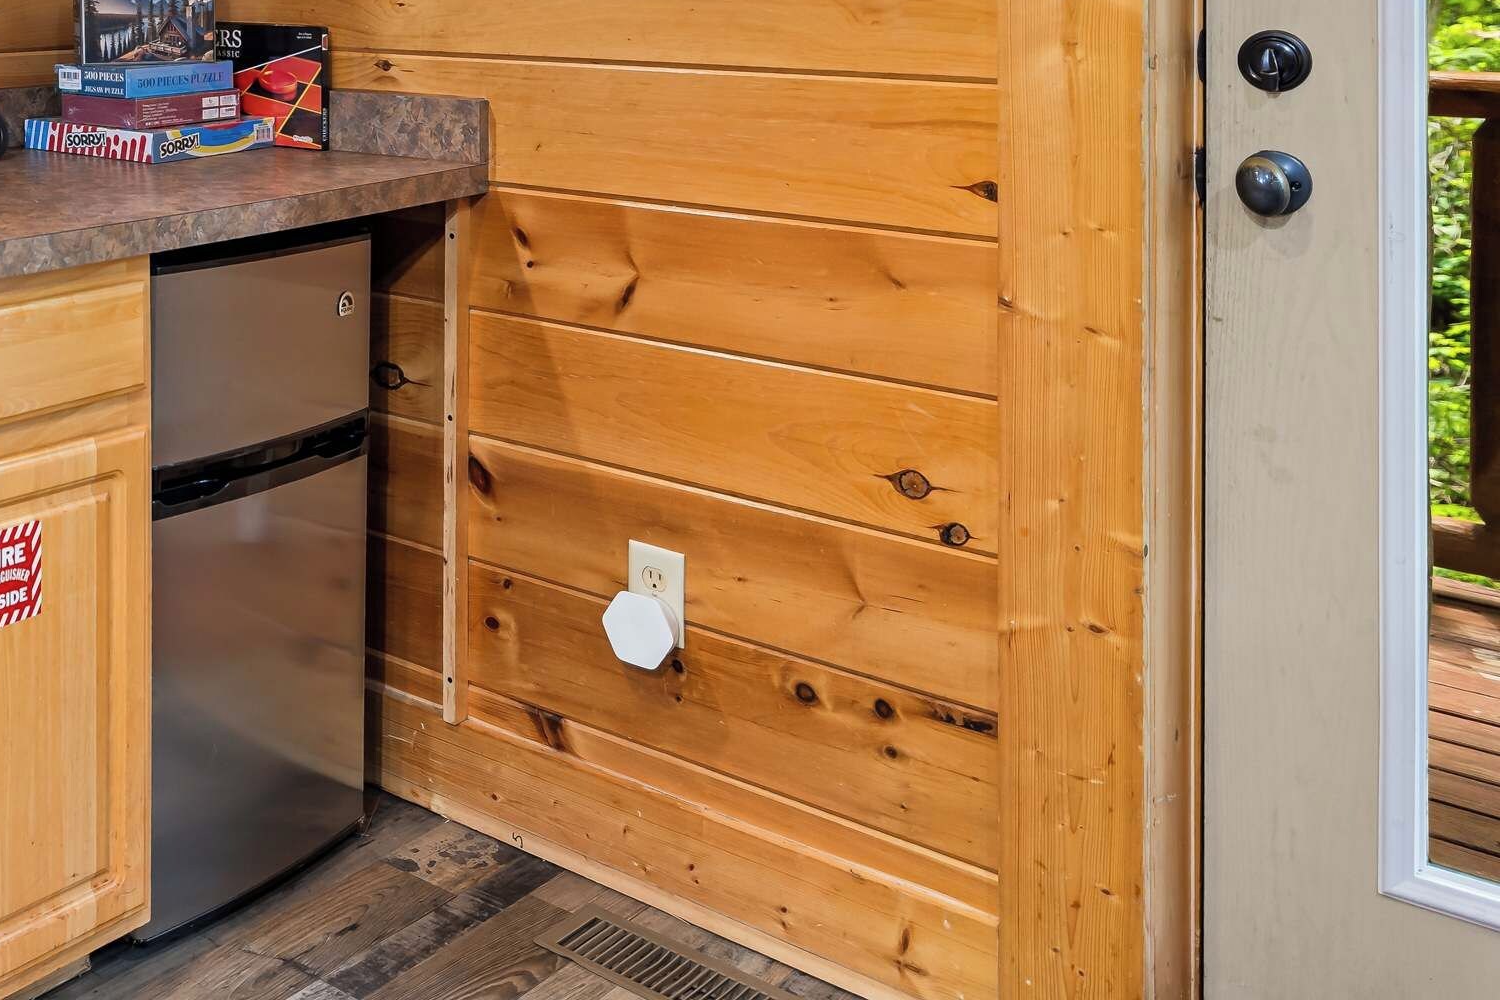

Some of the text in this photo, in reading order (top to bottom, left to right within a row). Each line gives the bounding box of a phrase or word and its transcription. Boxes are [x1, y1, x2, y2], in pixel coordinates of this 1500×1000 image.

[83, 71, 125, 83] 500 PIECES
[137, 71, 225, 89] 500 PIECES PUZZLE
[84, 85, 125, 95] JIGSAW PUZZLE
[66, 132, 106, 148] SORRY!
[160, 132, 200, 158] SORRY!
